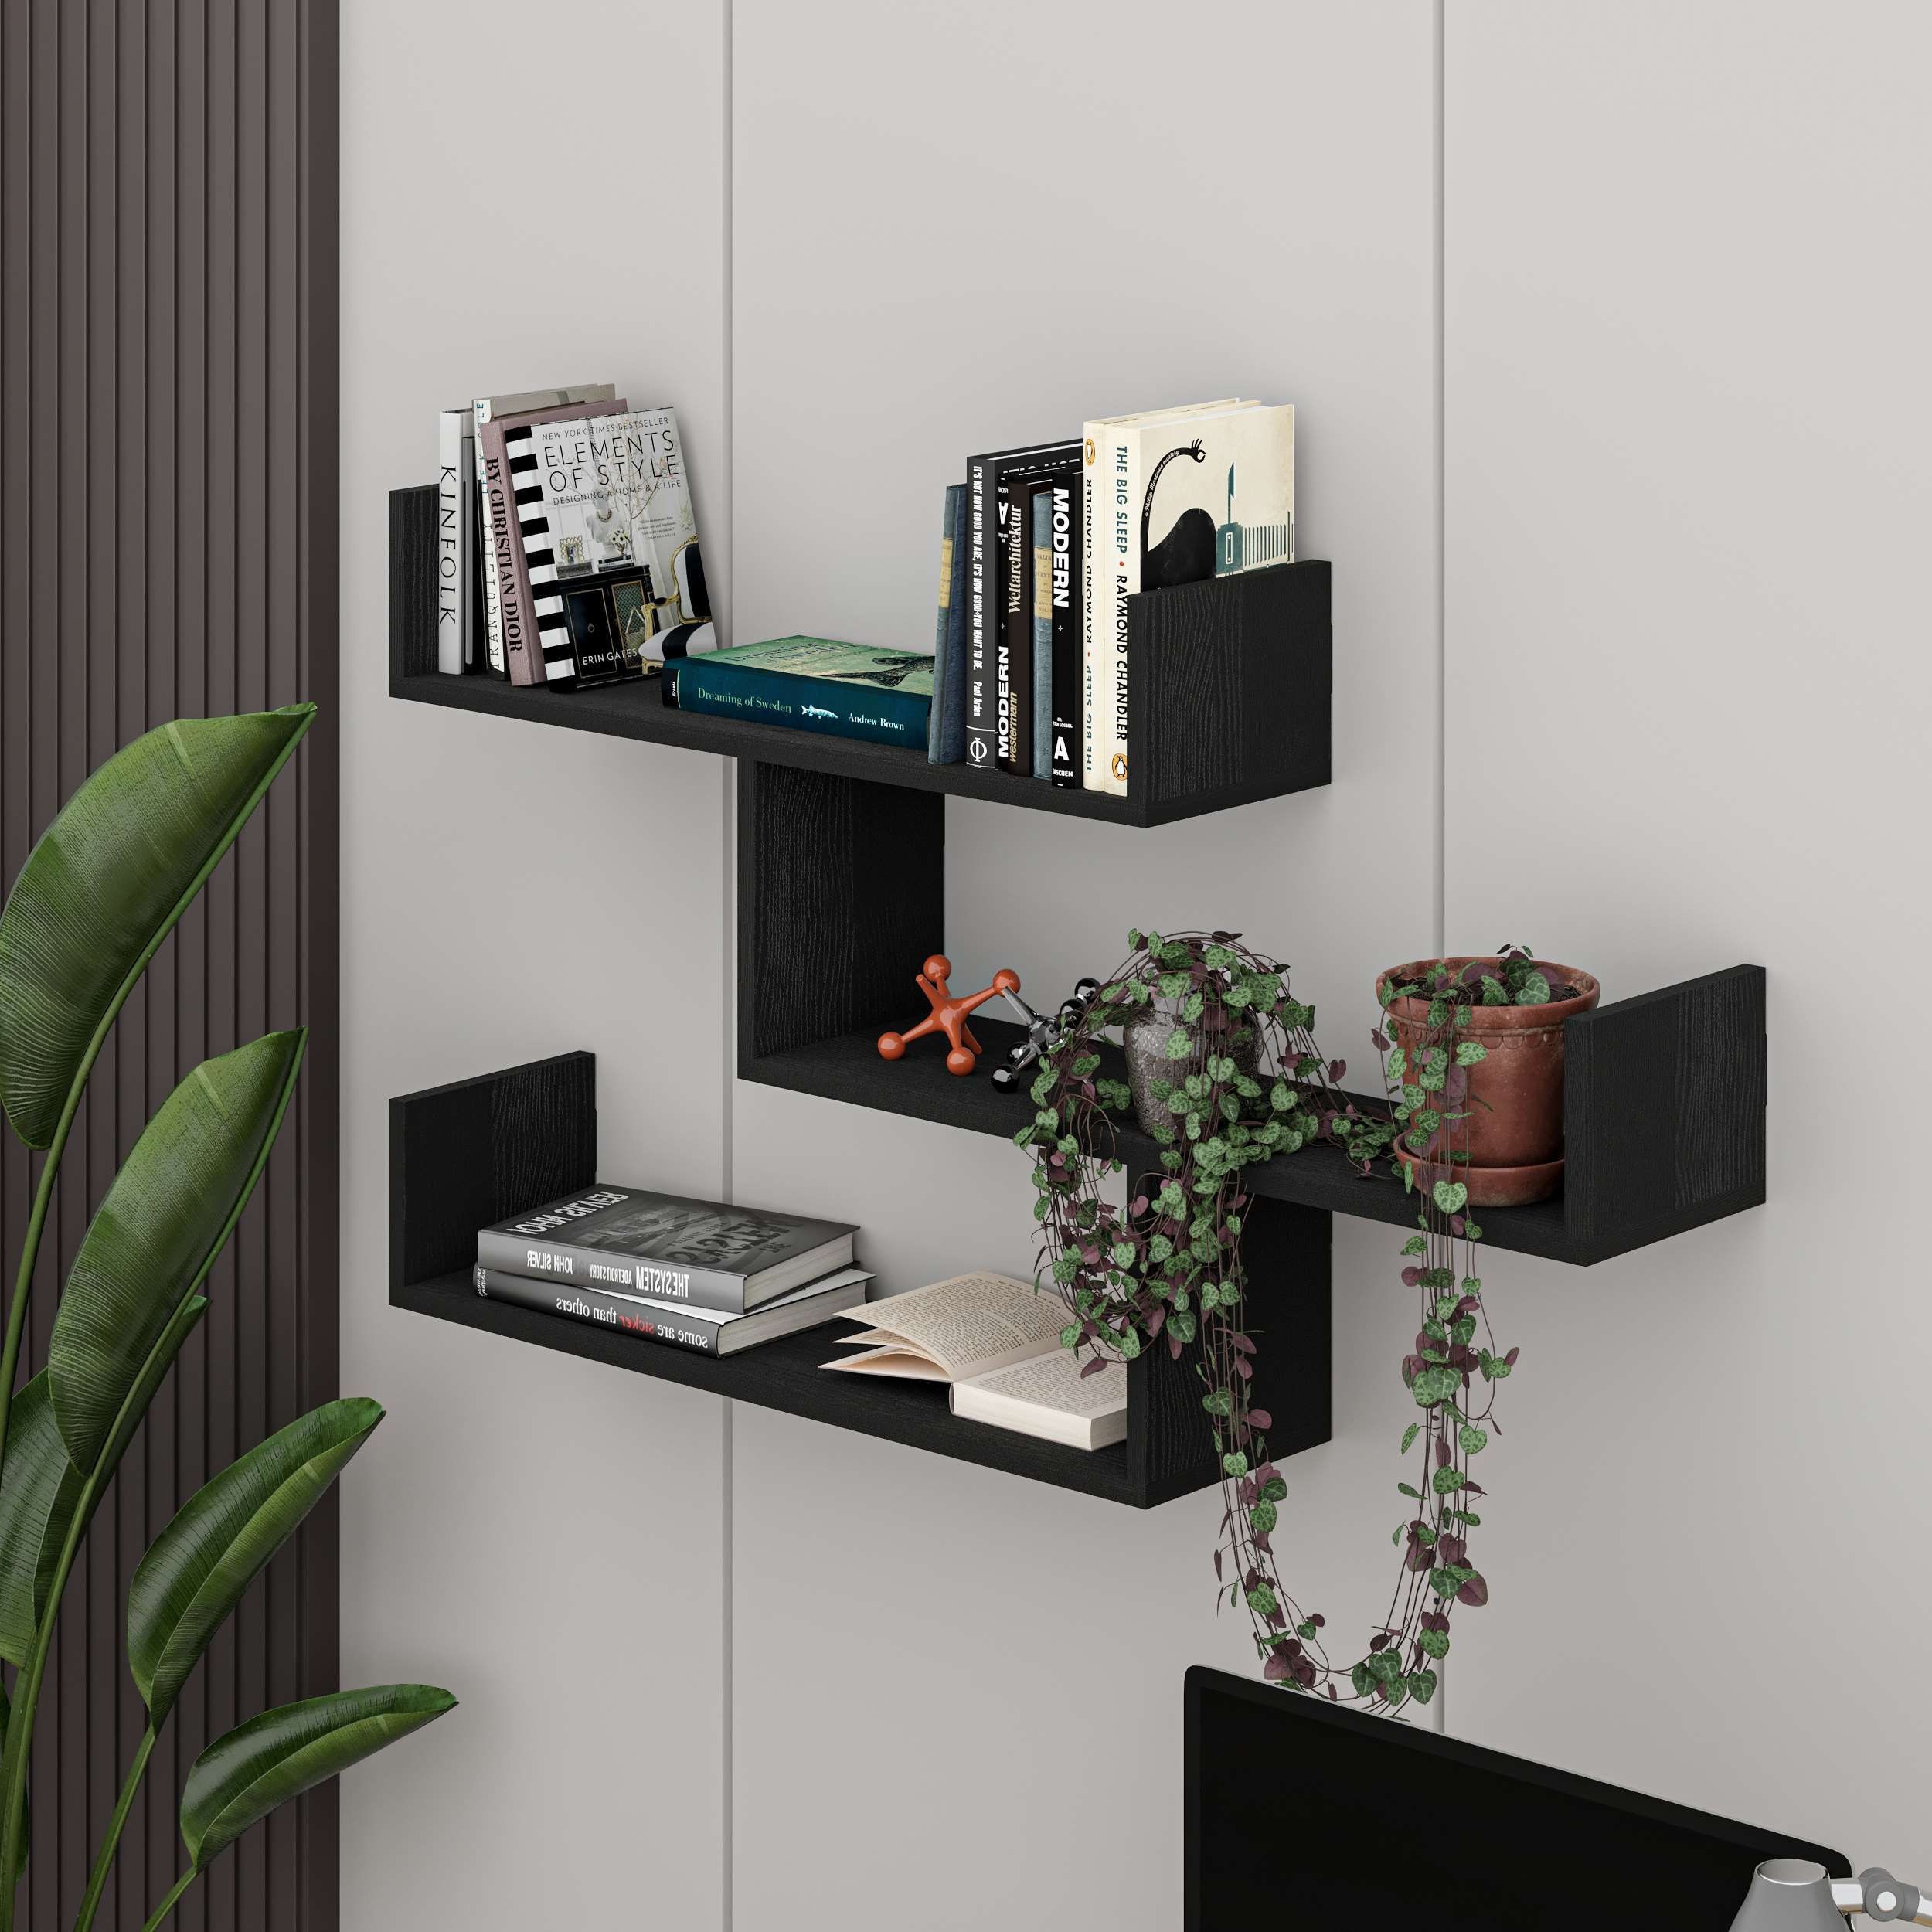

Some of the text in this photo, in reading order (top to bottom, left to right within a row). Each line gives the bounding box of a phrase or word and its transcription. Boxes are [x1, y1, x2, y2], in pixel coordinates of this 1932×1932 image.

[542, 417, 669, 440] NEW YORK TIMES BESTSELLER
[544, 430, 674, 468] ELEMENTS
[549, 454, 679, 492] OF STYLE
[553, 491, 604, 505] DESIGNING
[617, 484, 641, 496] HOME
[645, 483, 651, 492] &
[663, 479, 682, 489] LIFE
[974, 481, 983, 494] NOT
[974, 495, 983, 511] HOW
[974, 512, 983, 529] GOOD
[440, 464, 456, 624] KINFOLK
[974, 532, 983, 545] YOU
[1053, 488, 1070, 607] MODERN
[486, 457, 522, 652] BY CHRISTIAN DIOR
[1009, 505, 1022, 614] Weltarchitektur
[484, 524, 500, 669] TRANQUILITY
[974, 578, 983, 593] HOW
[1116, 446, 1128, 740] THE BIG SLEEP RAYMOND CHANDLER
[974, 630, 983, 648] WANT
[582, 648, 638, 665] ERIN GATES
[974, 650, 983, 658] TO
[698, 687, 792, 714] Dreaming of Sweden
[974, 682, 983, 717] Paul Arden
[998, 646, 1009, 758] MODERN
[849, 713, 905, 731] Andrew Brown
[1009, 692, 1018, 763] westermann
[1053, 736, 1070, 761] A
